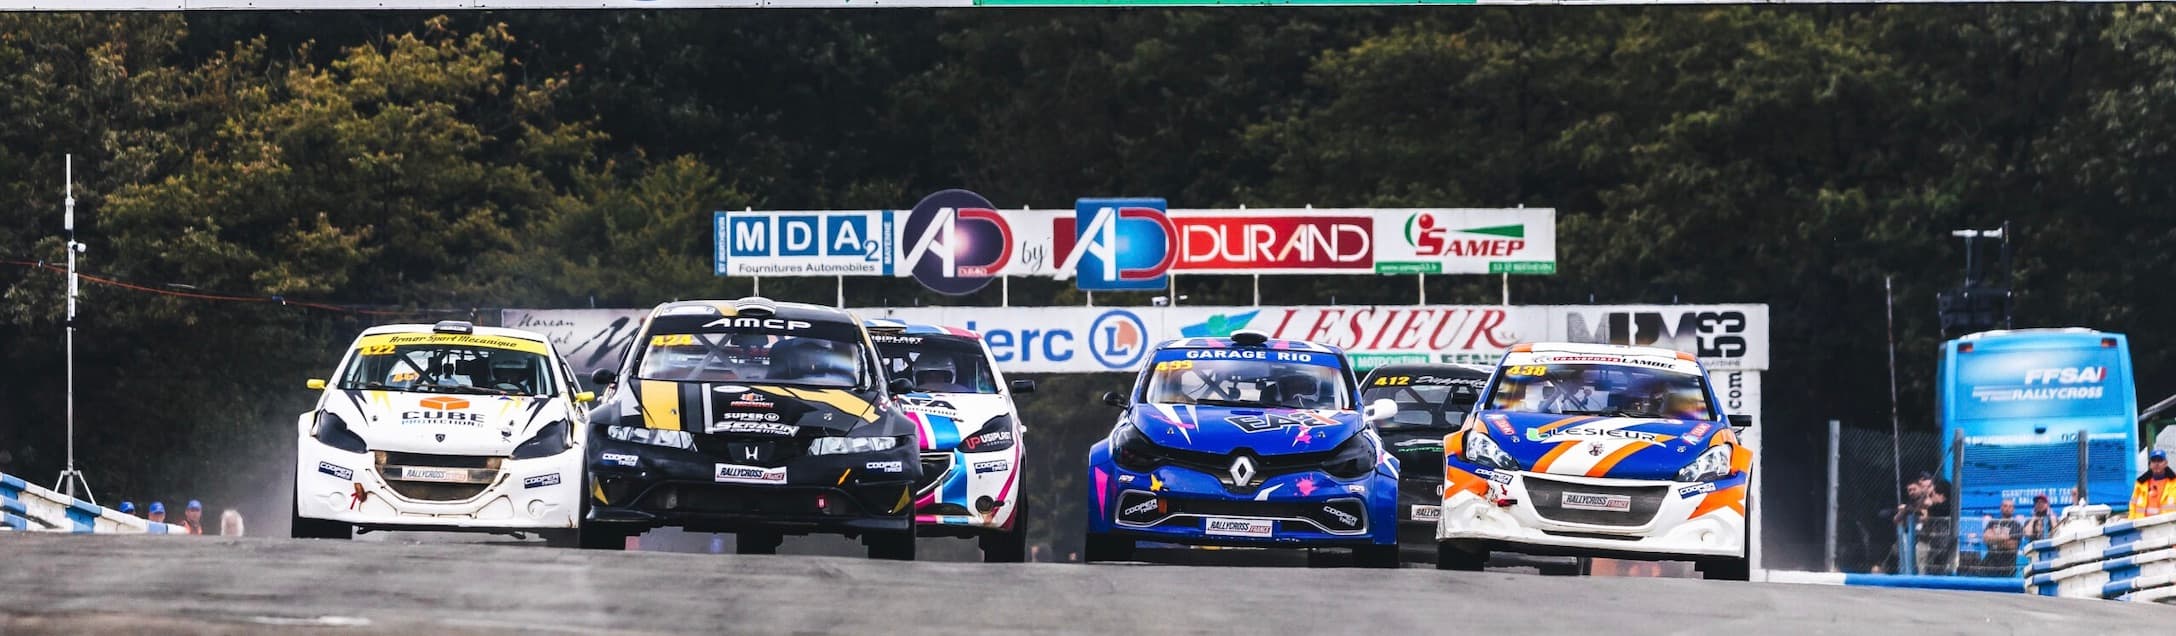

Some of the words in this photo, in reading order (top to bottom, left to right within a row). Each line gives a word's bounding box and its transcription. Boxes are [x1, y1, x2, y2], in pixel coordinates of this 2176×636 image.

[1181, 221, 1370, 264] DURAND
[1021, 239, 1044, 272] by
[739, 263, 801, 273] Fournitures
[805, 262, 875, 273] Automobiles
[702, 318, 812, 330] AMCP
[967, 321, 1074, 362] erc
[1186, 351, 1267, 360] GARAGE
[1277, 353, 1312, 362] RIO
[1505, 365, 1547, 376] 438
[2024, 366, 2099, 385] FFSA
[1374, 376, 1410, 385] 412
[2012, 386, 2104, 400] RALLYCROSS
[402, 411, 484, 423] CUBE
[1553, 428, 1657, 441] LESIEUR
[602, 453, 639, 462] COOPER
[866, 461, 902, 469] COOPER
[406, 469, 446, 478] RALLYCROSS
[720, 467, 764, 478] RALLYCROSS
[1566, 494, 1607, 504] RALLYCROSS
[1124, 498, 1157, 515] COOPER
[1323, 506, 1358, 522] COOPER
[1211, 521, 1250, 530] RALLYCROSS
